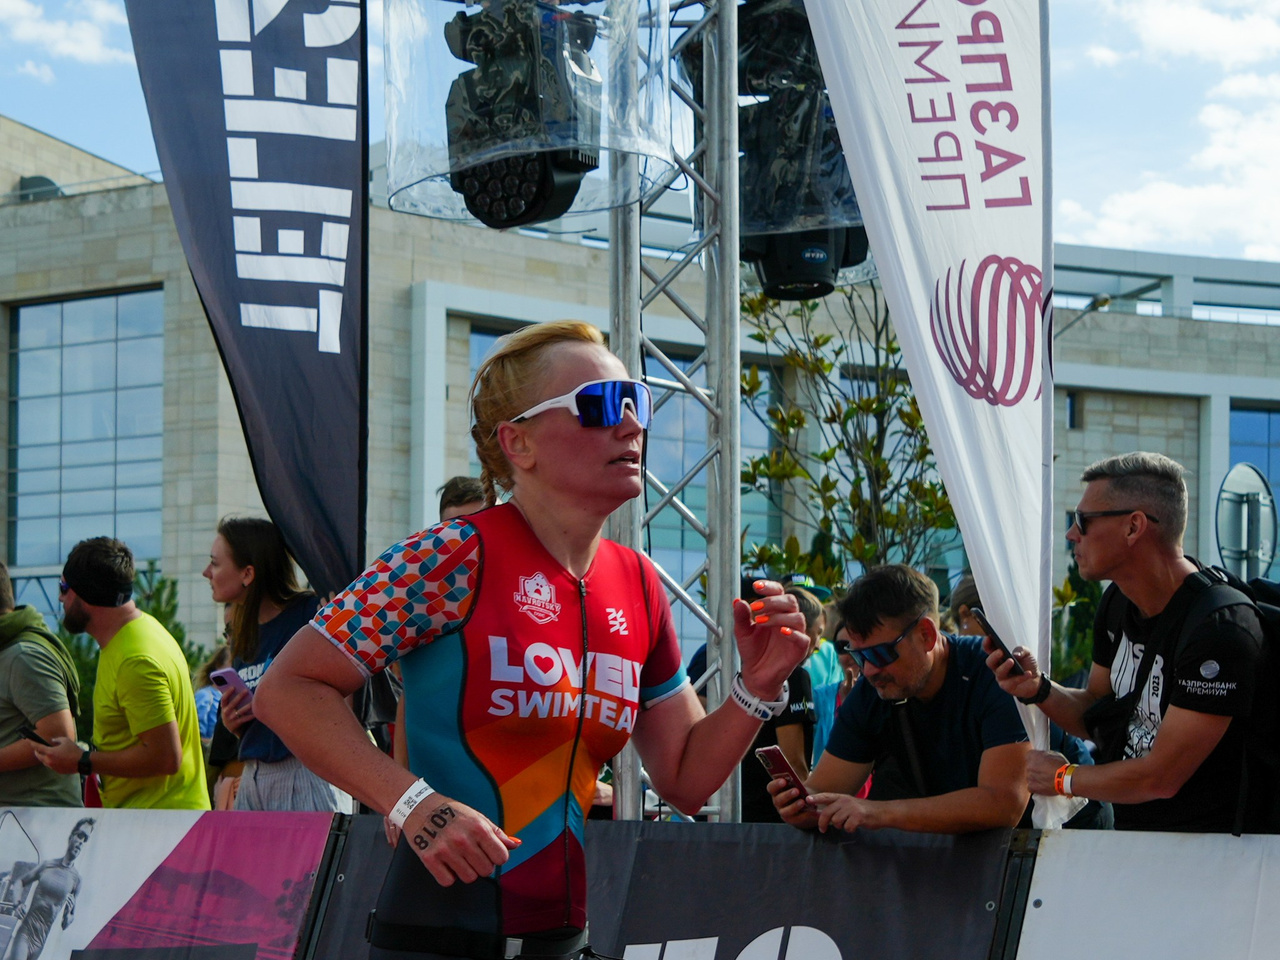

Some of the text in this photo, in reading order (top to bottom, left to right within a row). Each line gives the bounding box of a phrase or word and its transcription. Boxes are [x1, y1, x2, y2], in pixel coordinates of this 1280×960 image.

[1152, 675, 1160, 697] 2023
[1186, 686, 1227, 697] ПРЕМИУМ
[414, 806, 456, 850] 4018
